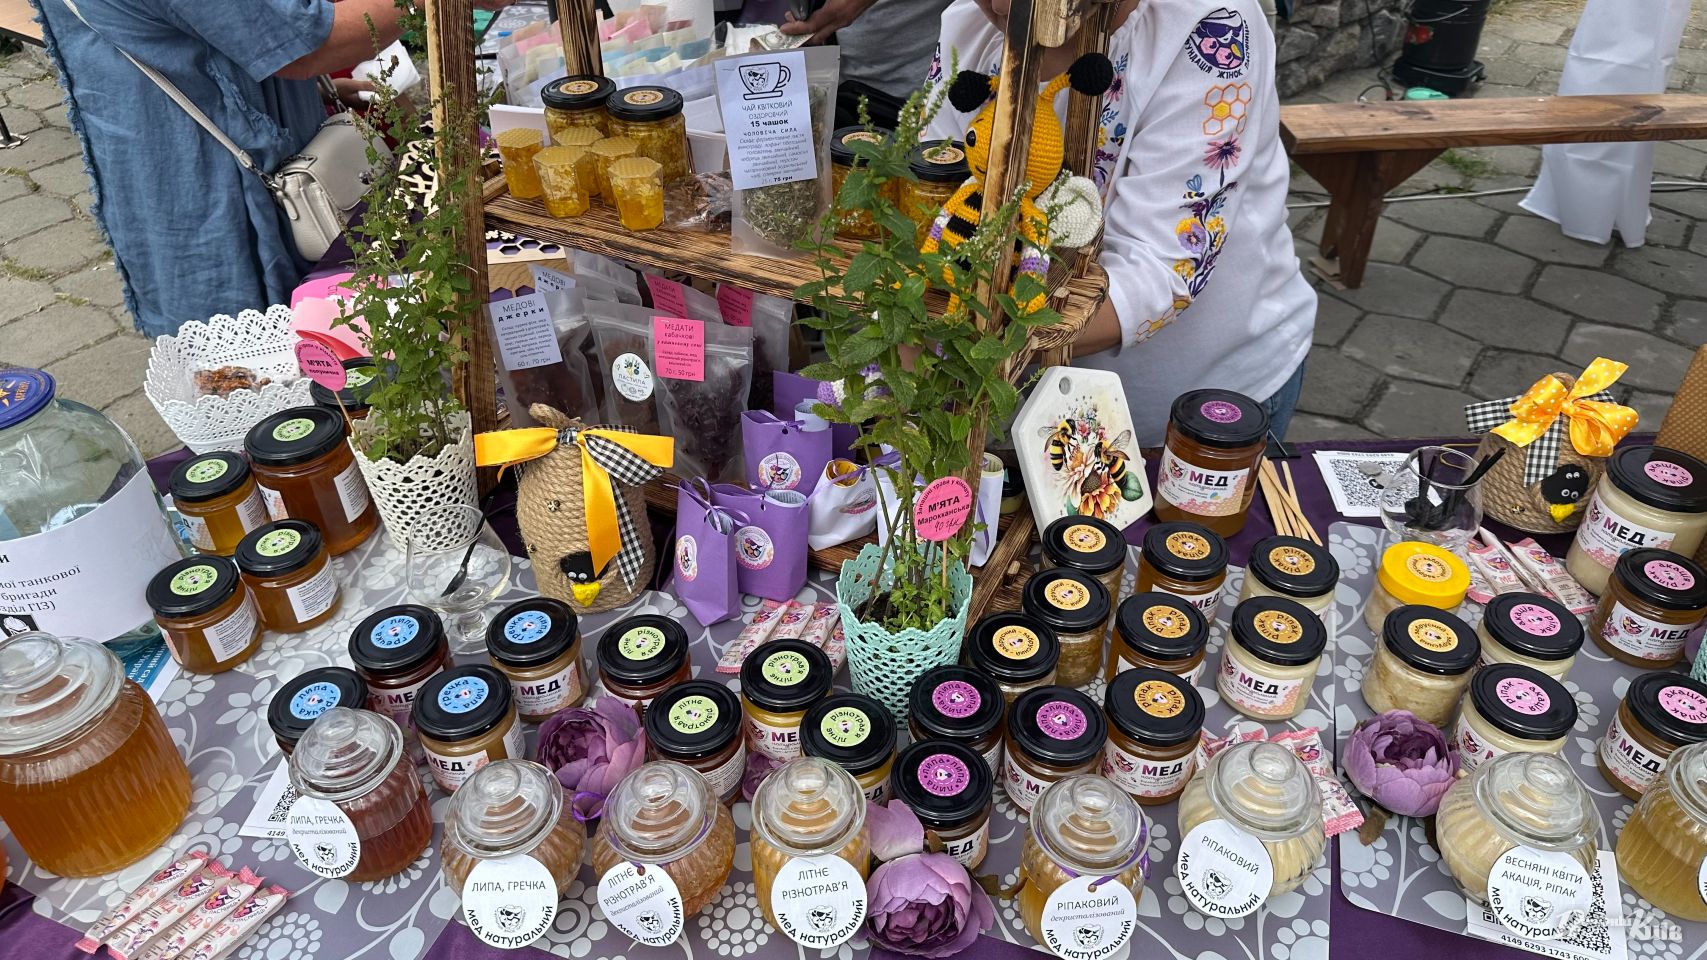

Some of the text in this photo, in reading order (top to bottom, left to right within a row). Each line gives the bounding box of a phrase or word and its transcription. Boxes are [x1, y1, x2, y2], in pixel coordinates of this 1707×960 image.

[1216, 68, 1244, 79] ЖІНОК
[748, 110, 788, 120] ОЗДОРОВЧИЙ
[758, 100, 792, 110] КВІТКОВИЙ
[542, 270, 566, 286] МЕДОВІ
[498, 307, 544, 322] джерки
[502, 300, 536, 313] МЕДОВІ
[664, 324, 694, 332] МЕДАТИ
[618, 373, 646, 386] ПАСТИЛА
[1189, 470, 1229, 487] МЕД
[918, 504, 970, 526] Марокканська
[928, 496, 960, 513] М'ЯТА
[1172, 534, 1202, 542] ріпак
[1603, 516, 1646, 546] МЕД
[1176, 550, 1205, 558] ріпак
[1274, 548, 1312, 573] ріпак ріпак
[18, 564, 81, 588] танкової
[180, 568, 211, 584] різнотрав'я
[1648, 563, 1691, 588] акація ріпак
[0, 588, 58, 603] бригади
[1191, 592, 1220, 609] МЕД
[508, 615, 548, 641] гречка липа
[1146, 610, 1187, 633] ріпак ріпак
[1258, 613, 1298, 640] ріпак ріпак
[1514, 606, 1558, 634] акація ріпак
[376, 618, 414, 646] липа гречка
[637, 628, 662, 657] різнотрав'я
[1650, 628, 1690, 640] МЕД
[768, 654, 806, 674] різнотрав'я
[299, 685, 328, 700] липа
[442, 680, 485, 709] гречка липа
[520, 678, 562, 696] МЕД
[1238, 672, 1279, 696] МЕД
[388, 691, 414, 704] МЕ
[938, 684, 977, 714] липа липа липа
[1138, 684, 1182, 714] ріпак ріпак
[1500, 682, 1546, 712] ріпак акація
[1665, 690, 1707, 721] акація ріпак
[674, 699, 714, 730] літне різнотрав'я
[830, 711, 866, 738] різнотрав'я
[1040, 704, 1082, 736] липа липа липа
[772, 732, 800, 742] МЕ
[428, 753, 466, 772] МЕД
[1619, 738, 1662, 774] МЕД
[922, 758, 965, 792] липа липа липа
[1142, 762, 1183, 776] МЕД
[1311, 766, 1326, 776] ЕД
[290, 816, 346, 825] ЛИПА, ГРЕЧКА
[312, 842, 357, 876] натуральний
[949, 839, 974, 857] ЕД
[1201, 836, 1260, 875] РІПАКОВИЙ
[608, 867, 635, 888] ЛІТНЄ
[798, 867, 830, 880] ЛІТНЄ
[1505, 855, 1583, 885] ВЕСНЯНІ КВІТИ
[472, 880, 546, 892] ЛИПА, ГРЕЧКА
[604, 874, 656, 907] РІЗНОТРАВ'Я
[782, 880, 848, 900] РІЗНОТРАВ'Я
[1502, 870, 1577, 898] АКАЦІЯ, РІПАК
[1057, 896, 1120, 911] РІПАКОВИЙ
[1186, 882, 1260, 915] натуральний
[484, 905, 554, 947] натуральний
[642, 897, 681, 944] натуральний
[800, 899, 864, 946] натуральний
[1064, 920, 1132, 960] натуральний
[1500, 934, 1522, 946] 4149
[1524, 942, 1546, 953] 6293
[1548, 948, 1572, 960] 1743
